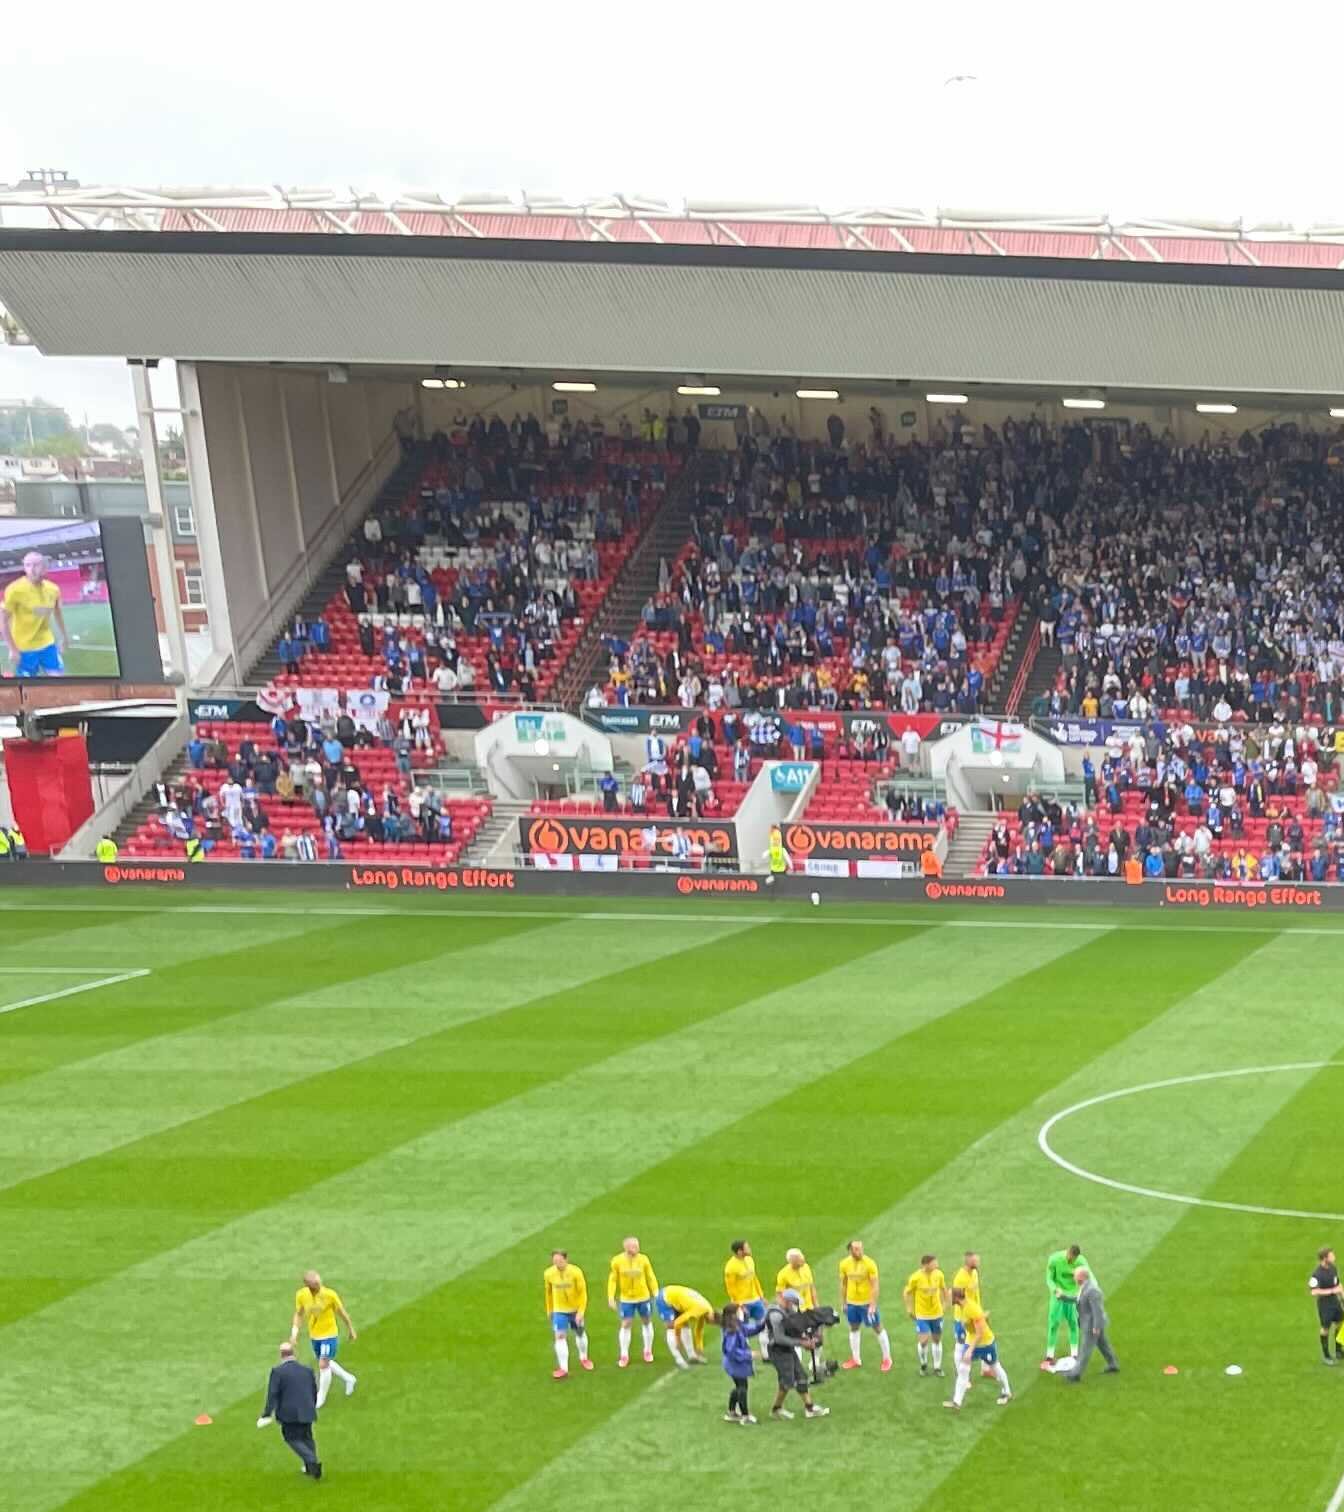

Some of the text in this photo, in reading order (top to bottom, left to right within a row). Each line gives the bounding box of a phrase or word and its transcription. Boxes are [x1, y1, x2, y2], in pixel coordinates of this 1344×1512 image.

[120, 868, 185, 881] vanarama
[352, 868, 514, 890] Long Range Effort
[692, 880, 758, 893] vanarama
[942, 885, 1005, 898] vanarama
[1166, 887, 1321, 907] Long Range Effort
